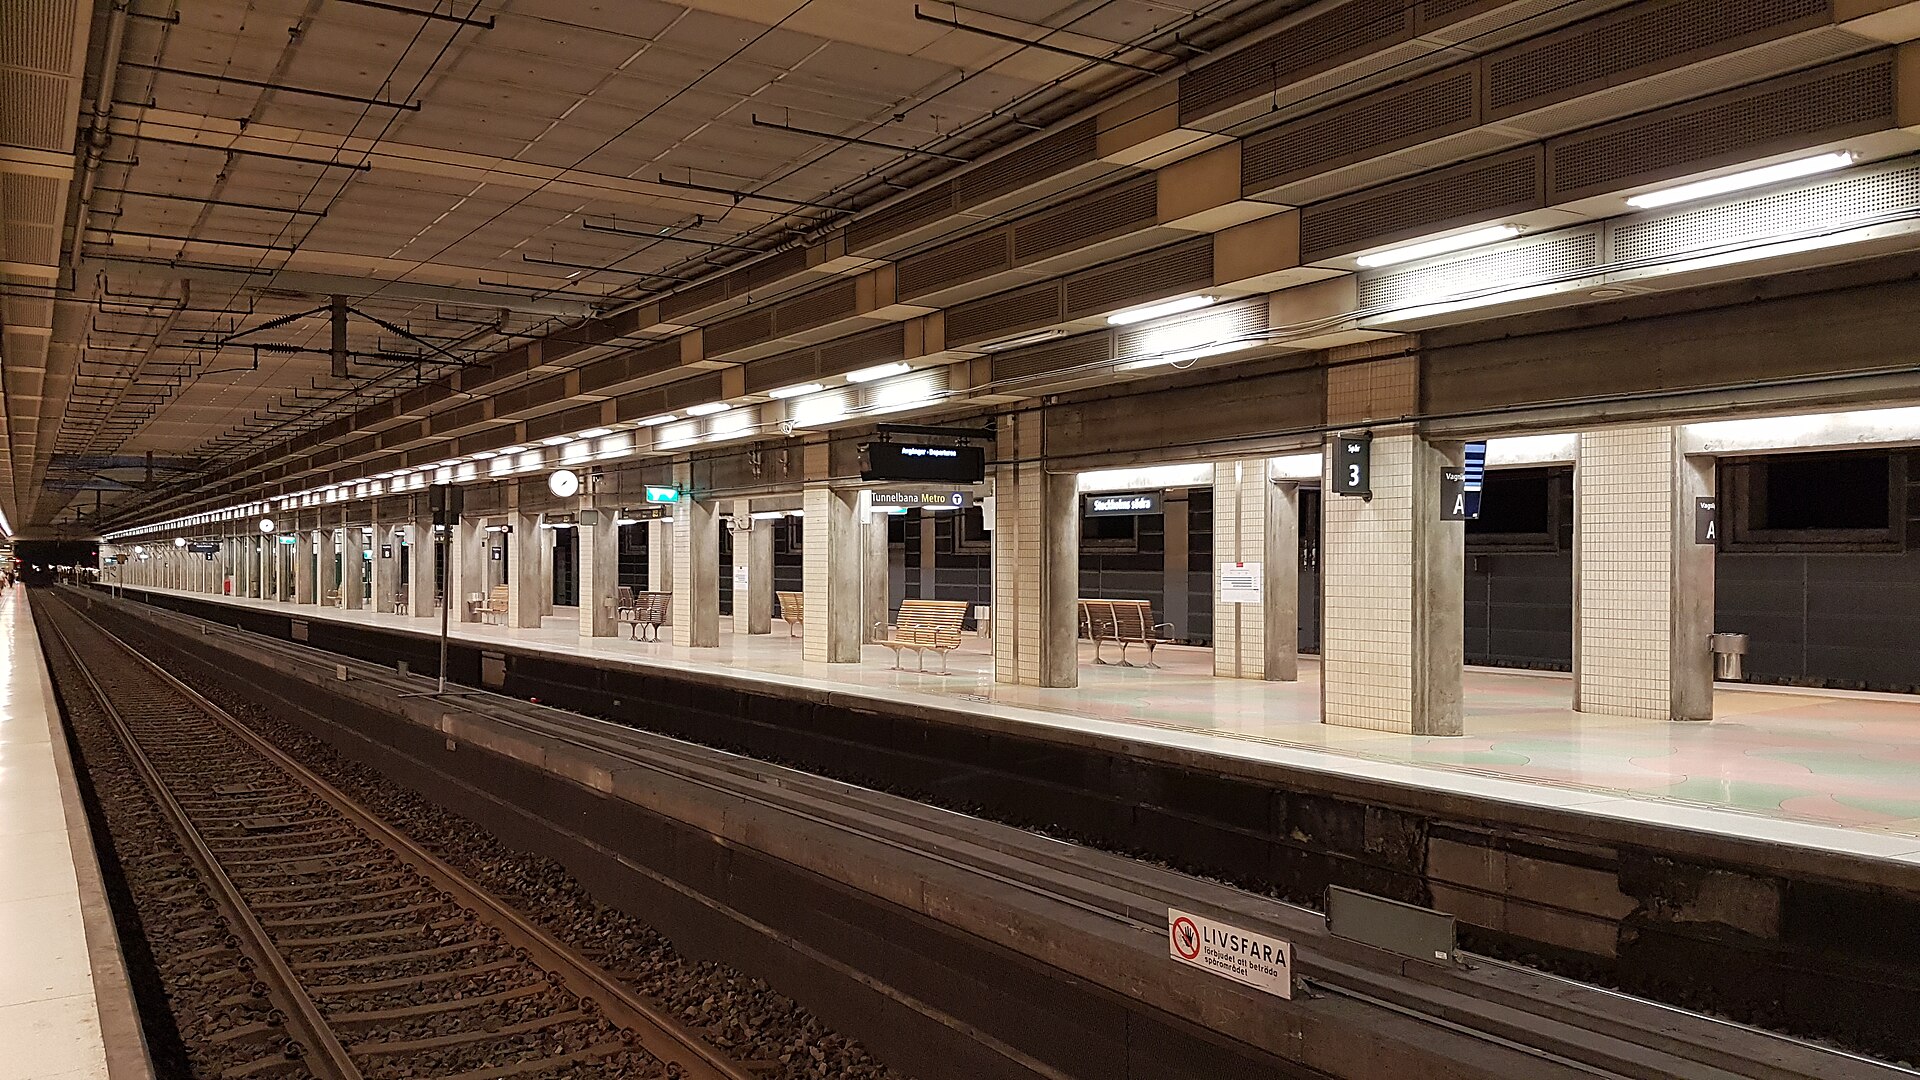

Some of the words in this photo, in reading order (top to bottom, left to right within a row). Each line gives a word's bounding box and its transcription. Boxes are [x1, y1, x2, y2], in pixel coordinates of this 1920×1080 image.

[1348, 464, 1360, 487] 3
[872, 492, 919, 503] Tunnelbana
[921, 493, 946, 503] Metro
[1452, 493, 1465, 515] A
[1706, 520, 1716, 539] A
[1203, 926, 1287, 967] LIVSFARA
[1204, 946, 1236, 963] förbjudet
[1237, 958, 1247, 967] att
[1249, 961, 1278, 977] beträda
[1204, 956, 1248, 976] spårområdet
